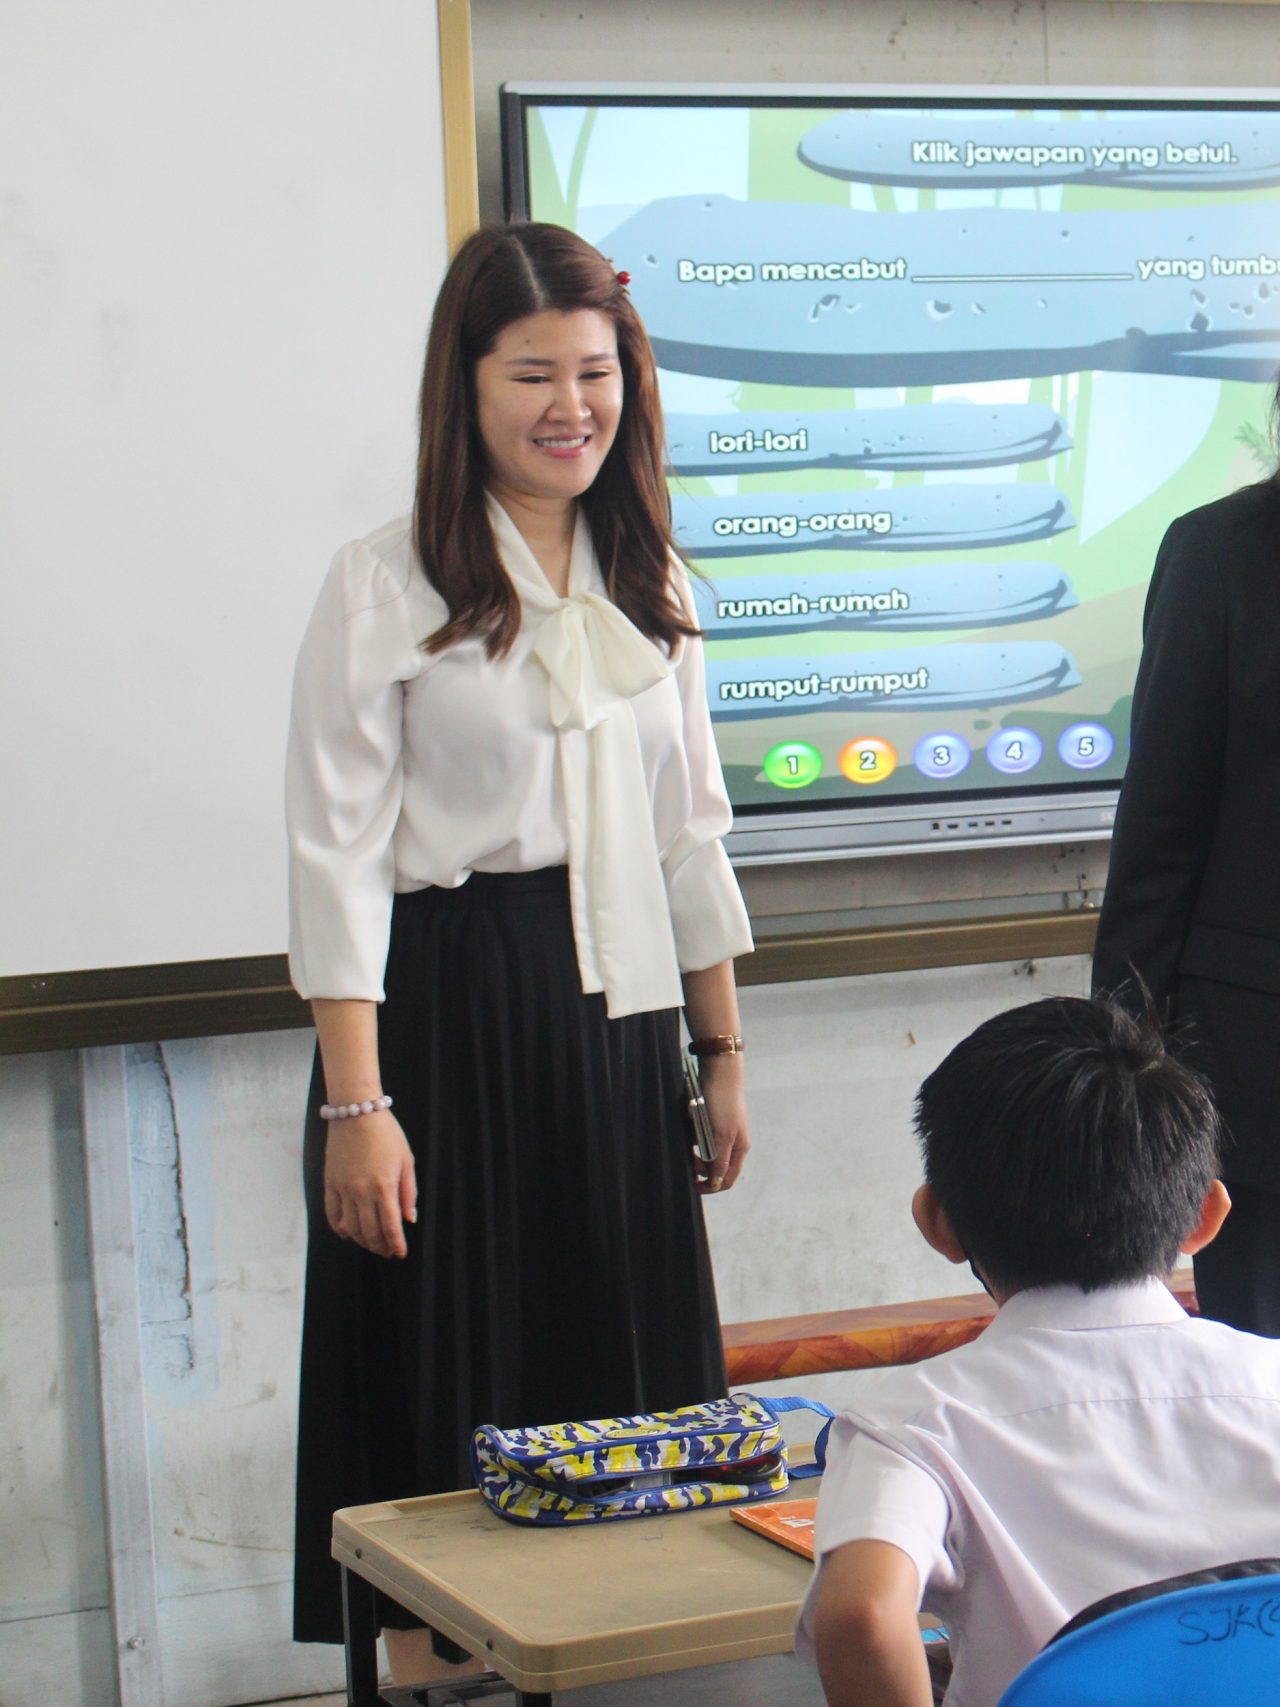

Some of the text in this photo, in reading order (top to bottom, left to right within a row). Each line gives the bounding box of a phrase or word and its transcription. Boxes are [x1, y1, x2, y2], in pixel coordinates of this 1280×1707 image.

[911, 141, 1238, 169] Klik jawapan yang betul.
[679, 260, 753, 284] Bapa
[761, 258, 907, 281] mencabut
[1137, 258, 1204, 279] yang
[709, 430, 807, 453] lori-lori
[713, 512, 892, 538] orang-orang
[717, 589, 909, 618] rumah-rumah
[720, 669, 929, 702] rumput-rumput
[788, 737, 1095, 774] 1 2 3 4 5
